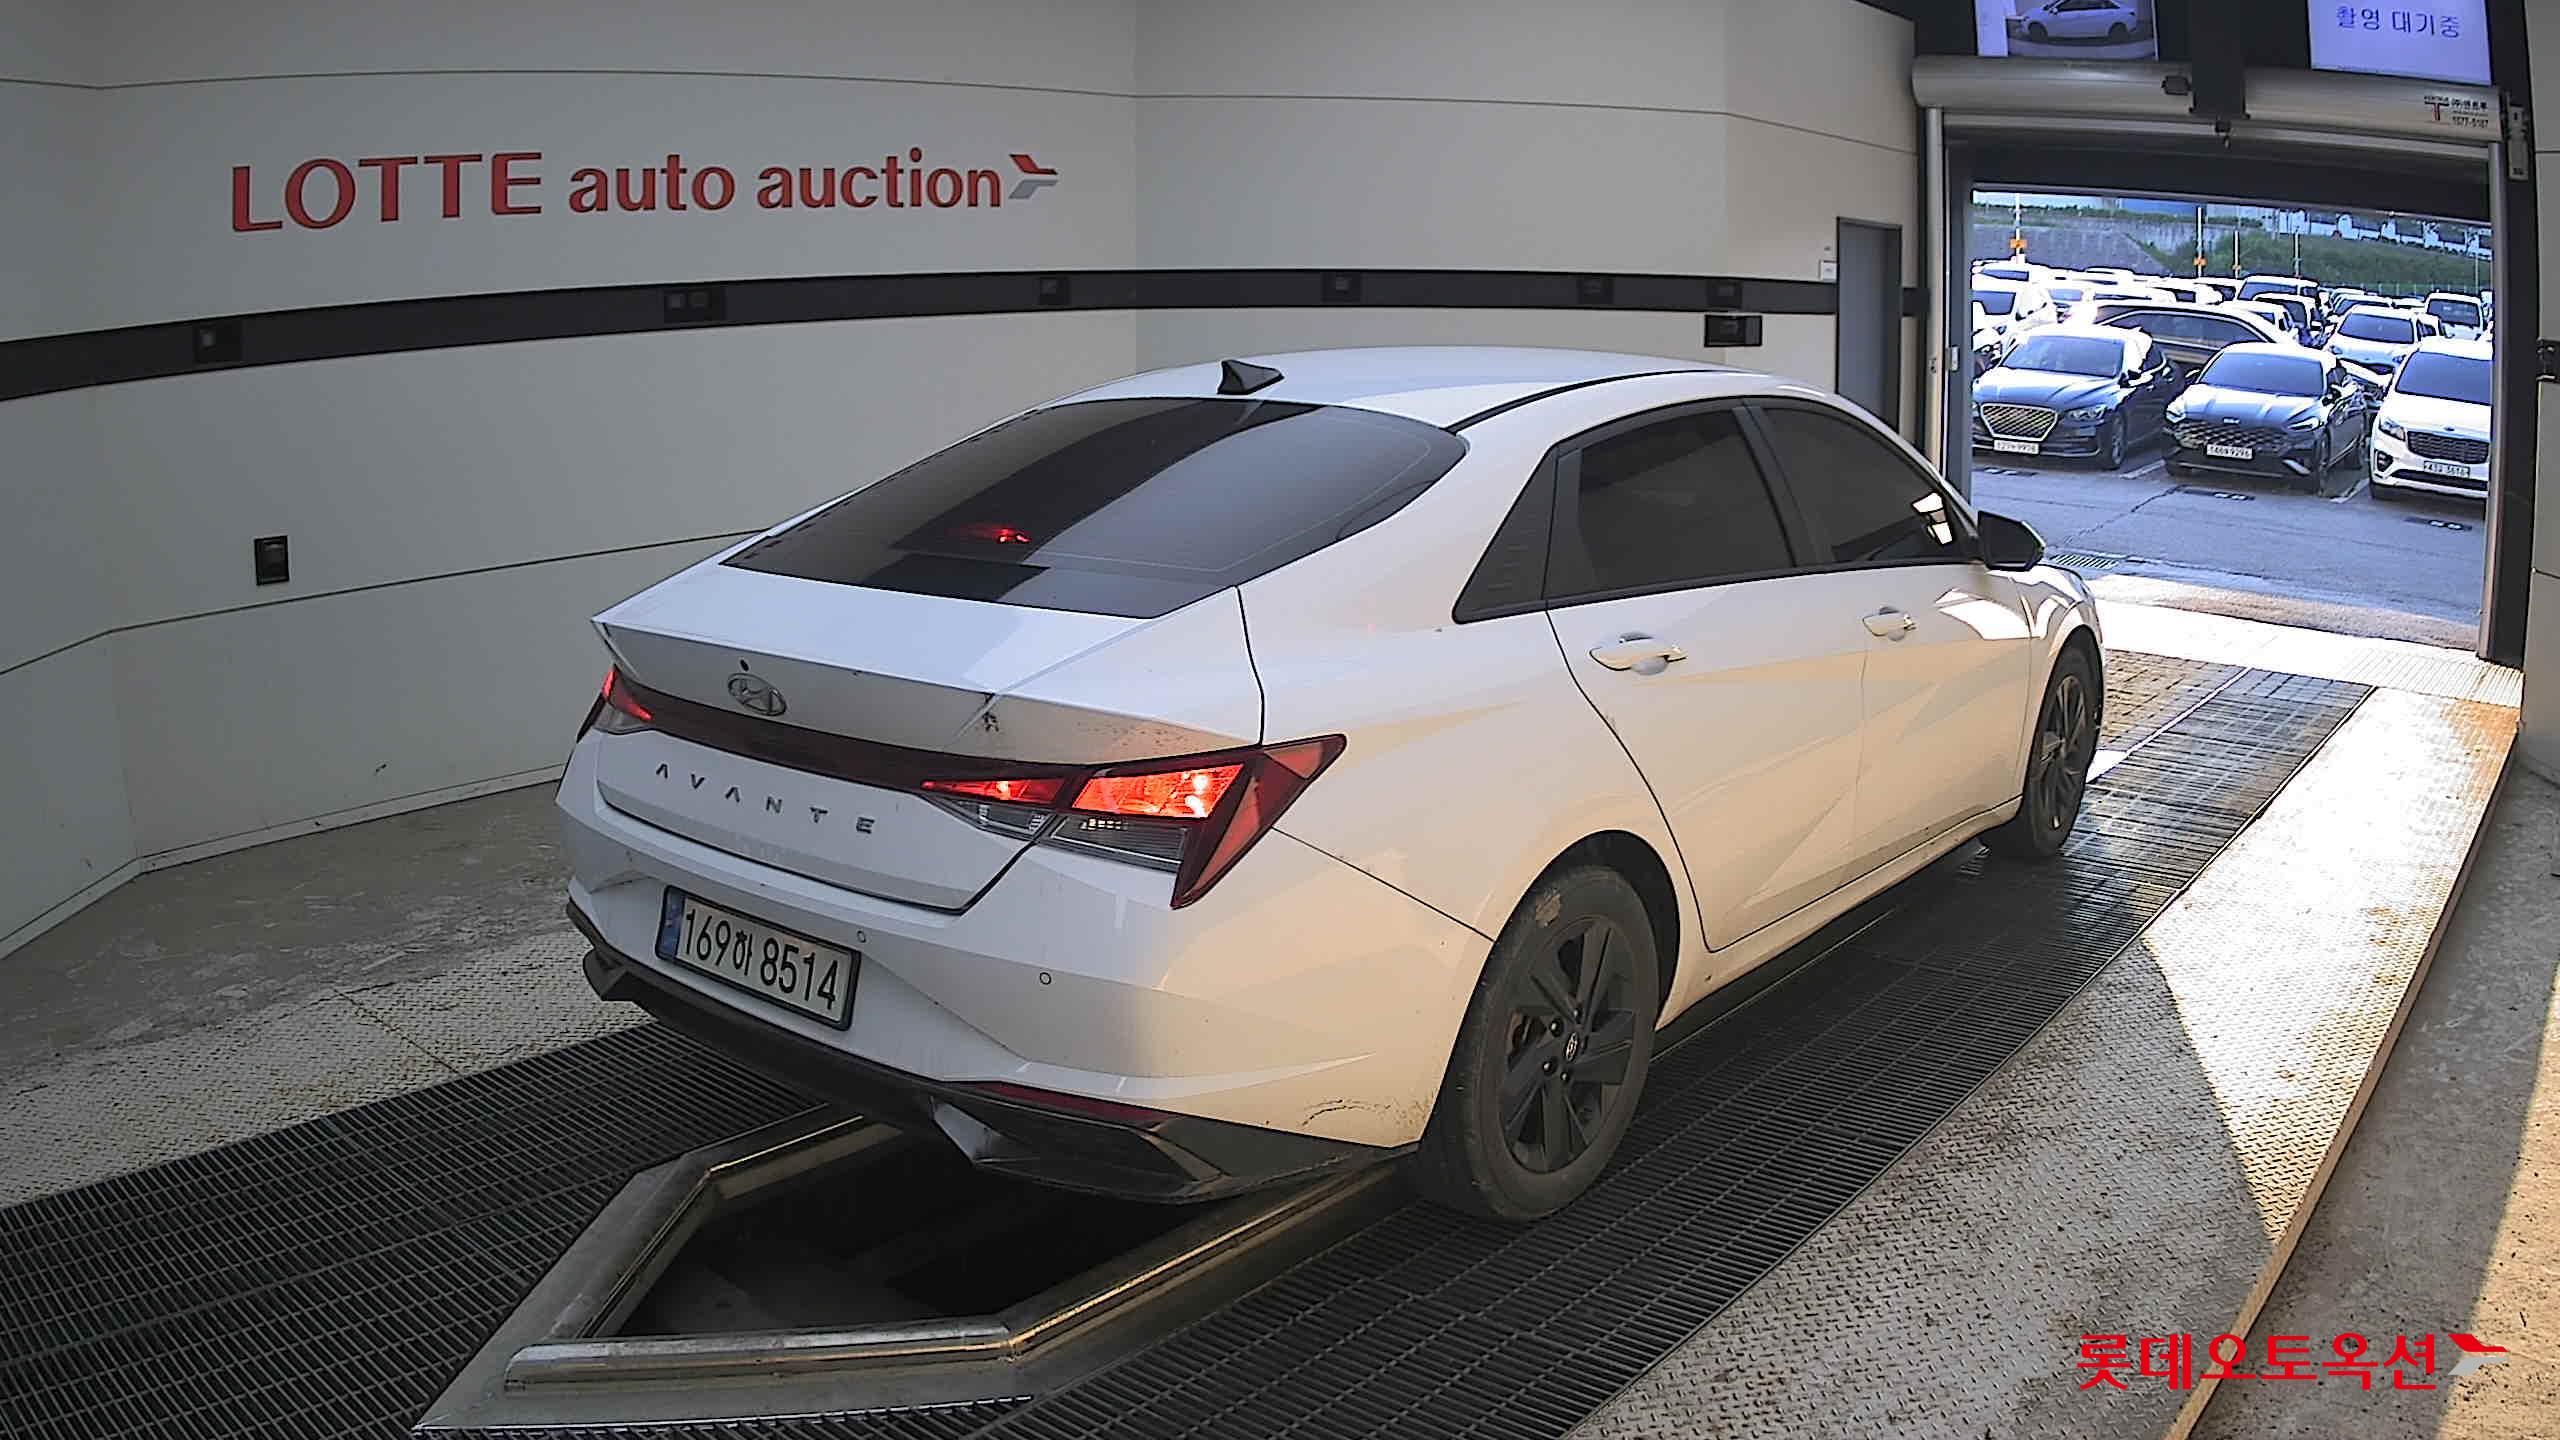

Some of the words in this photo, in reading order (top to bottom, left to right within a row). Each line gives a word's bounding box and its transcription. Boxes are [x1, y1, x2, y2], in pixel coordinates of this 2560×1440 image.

[2337, 6, 2381, 31] 촬영
[2391, 10, 2460, 39] 대기중
[232, 151, 543, 233] LOTTE
[567, 153, 736, 213] auto
[756, 147, 1002, 209] auction
[655, 763, 876, 835] AVANTE
[685, 907, 754, 977] 169하
[759, 937, 841, 1011] 8514
